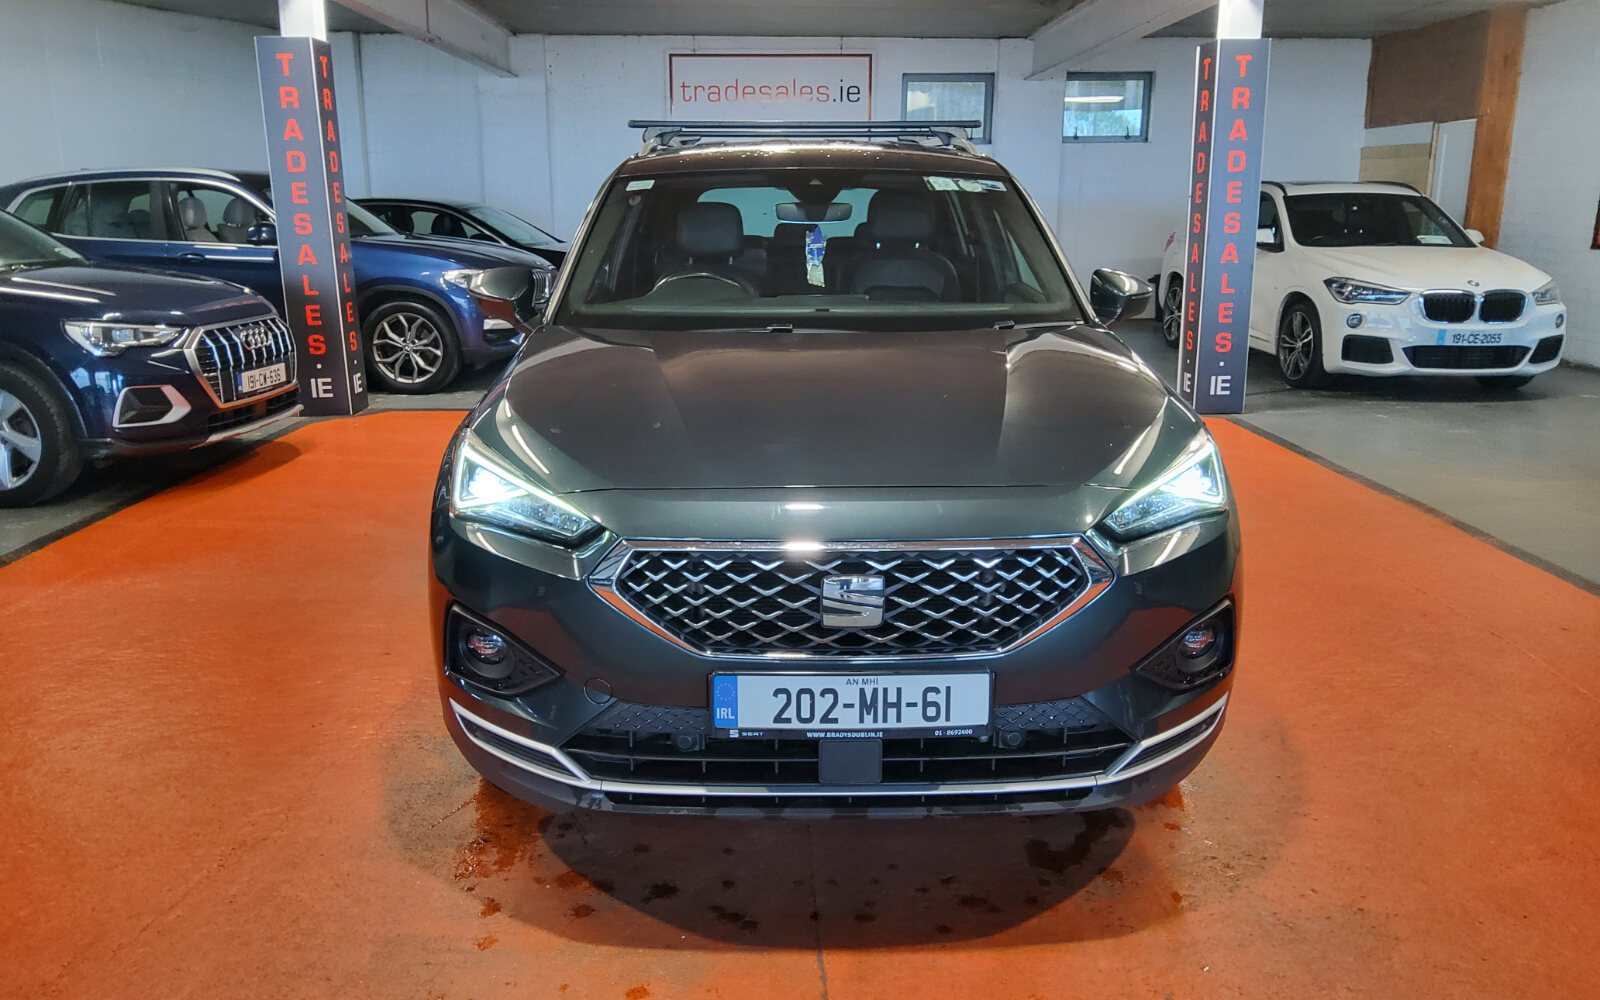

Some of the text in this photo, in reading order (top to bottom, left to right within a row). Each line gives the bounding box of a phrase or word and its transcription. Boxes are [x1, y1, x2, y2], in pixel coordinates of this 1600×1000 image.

[680, 78, 861, 103] tradesales.ie
[1451, 333, 1502, 344] 191-CE-2055
[845, 678, 859, 686] AN
[772, 686, 952, 724] 202-MH-61
[716, 707, 736, 720] IRL
